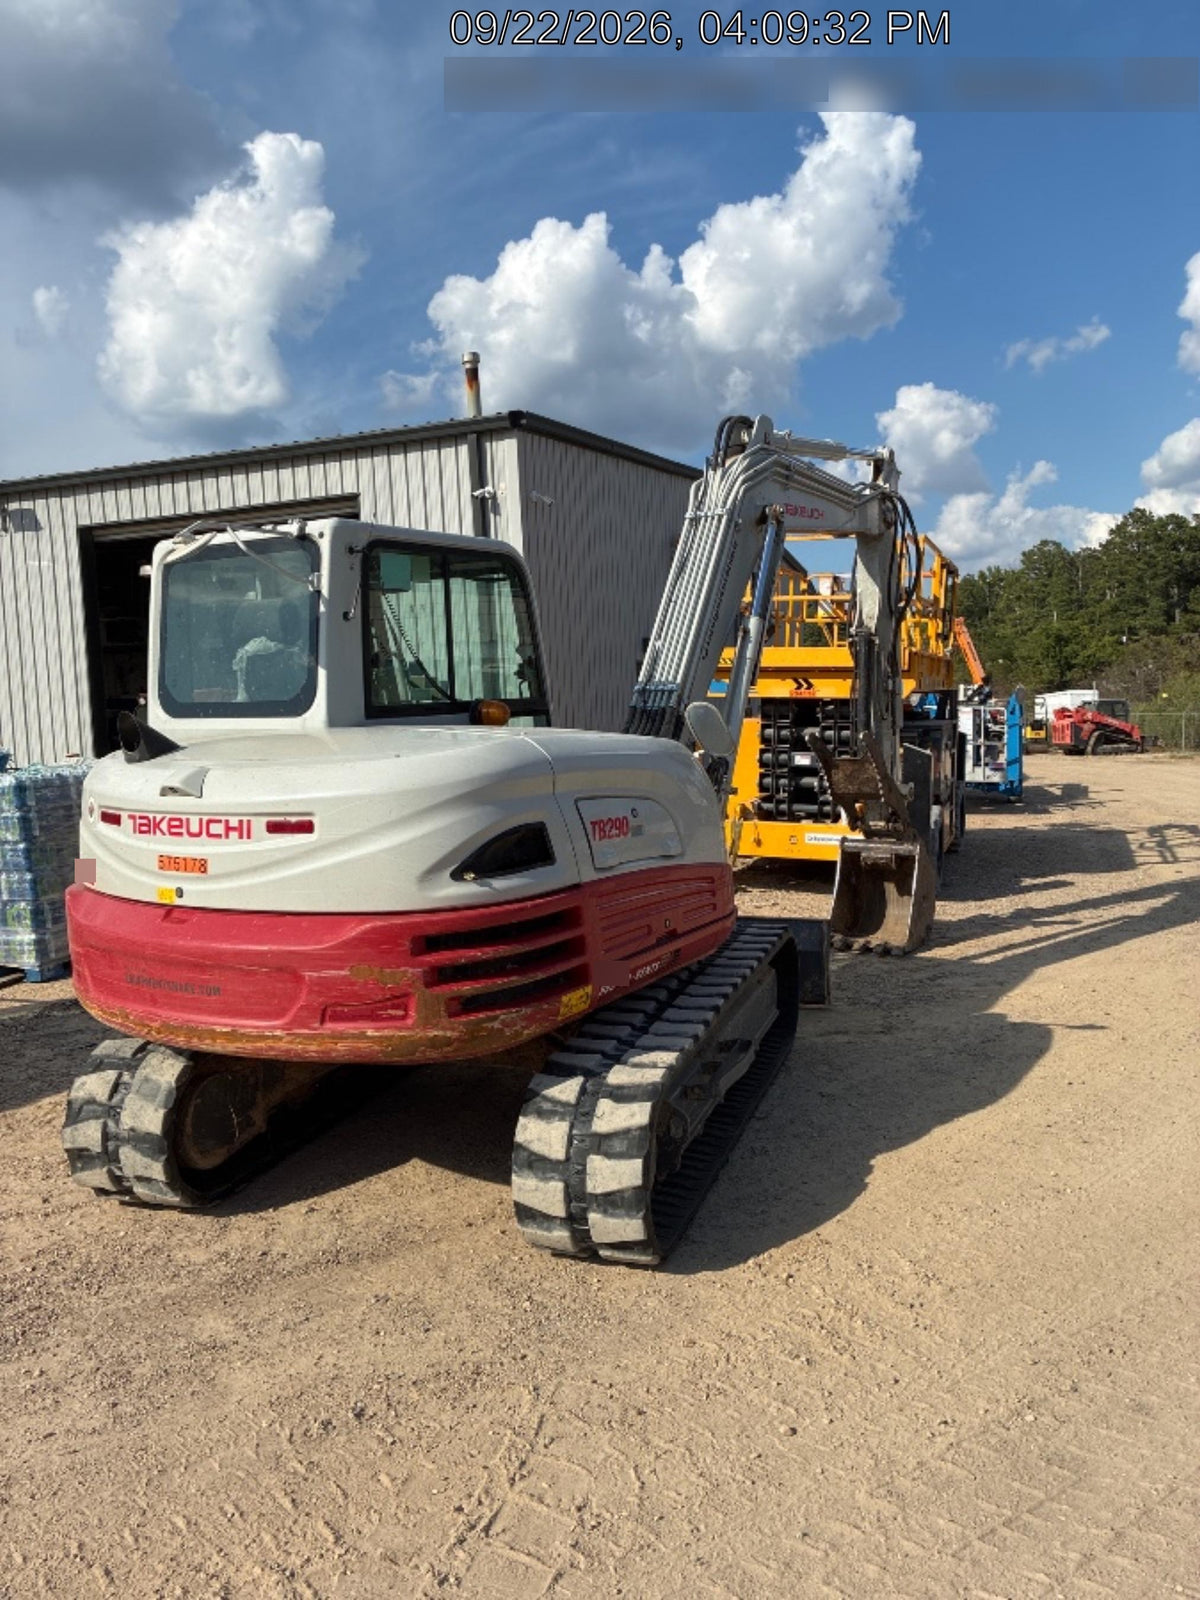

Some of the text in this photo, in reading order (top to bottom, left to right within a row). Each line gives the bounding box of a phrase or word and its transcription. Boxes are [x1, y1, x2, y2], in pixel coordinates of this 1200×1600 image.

[127, 814, 251, 839] TAKEUCHI
[590, 815, 629, 841] TB290
[158, 854, 208, 874] 575178
